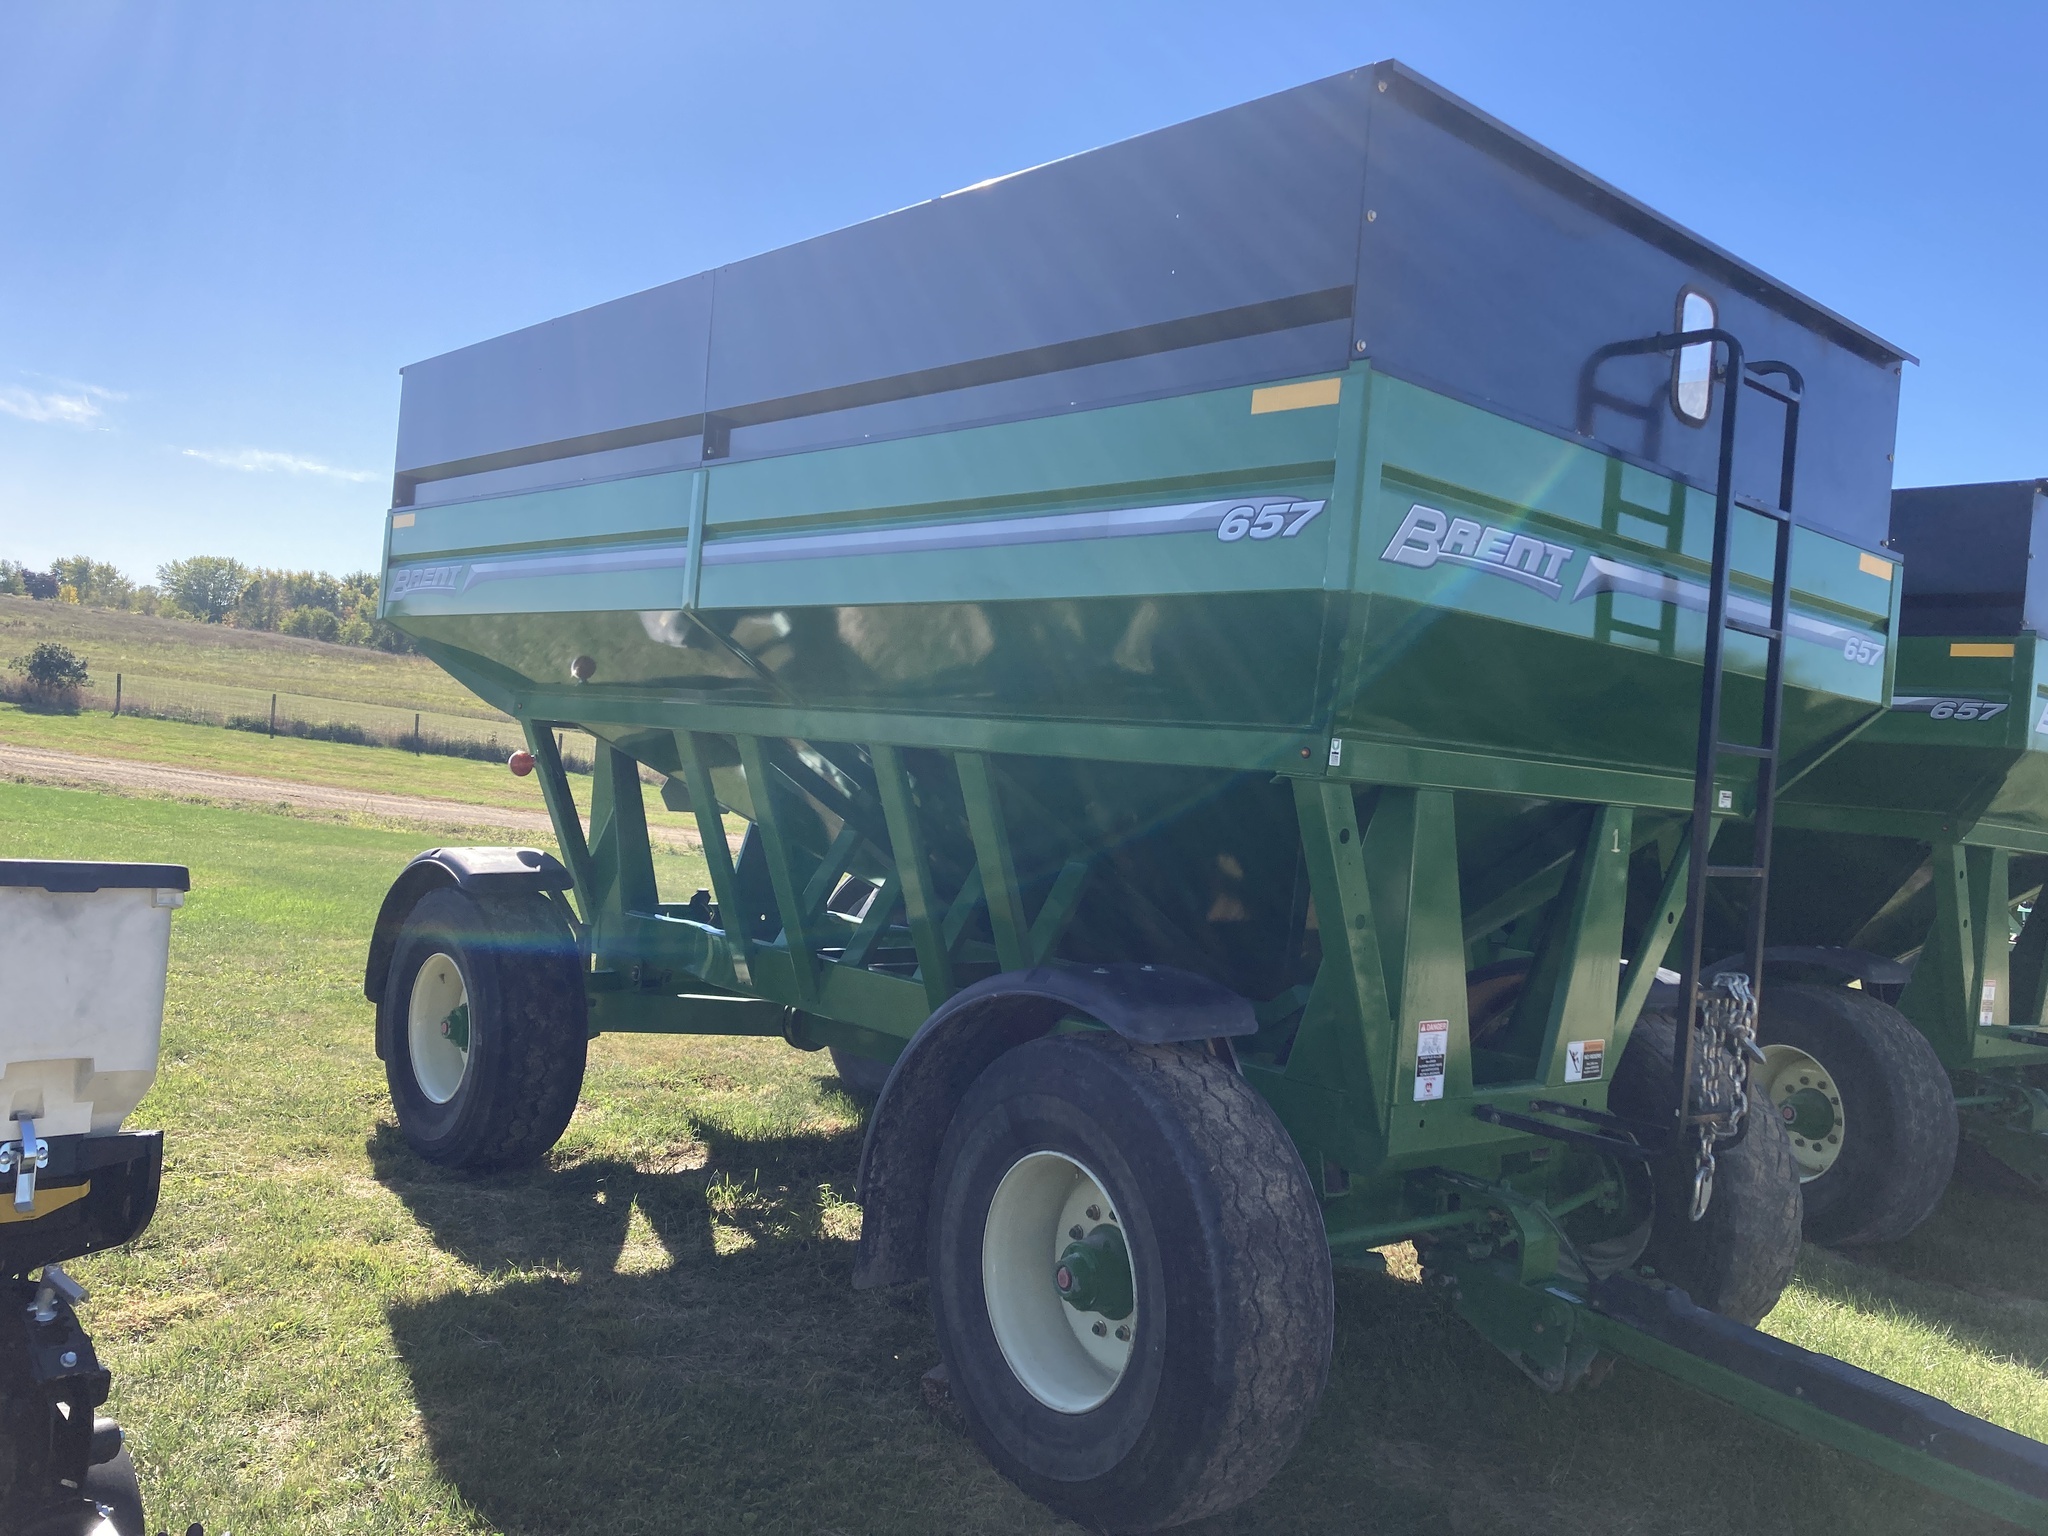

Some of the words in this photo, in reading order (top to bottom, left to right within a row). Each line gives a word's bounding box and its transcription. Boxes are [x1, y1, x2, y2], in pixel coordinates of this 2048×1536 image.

[1217, 499, 1327, 543] 657
[1379, 502, 1575, 600] BRENT
[387, 565, 463, 602] BRENT
[1843, 636, 1885, 666] 657
[1929, 701, 2009, 721] 657
[1610, 828, 1621, 853] 1
[1426, 1022, 1447, 1031] DANGER
